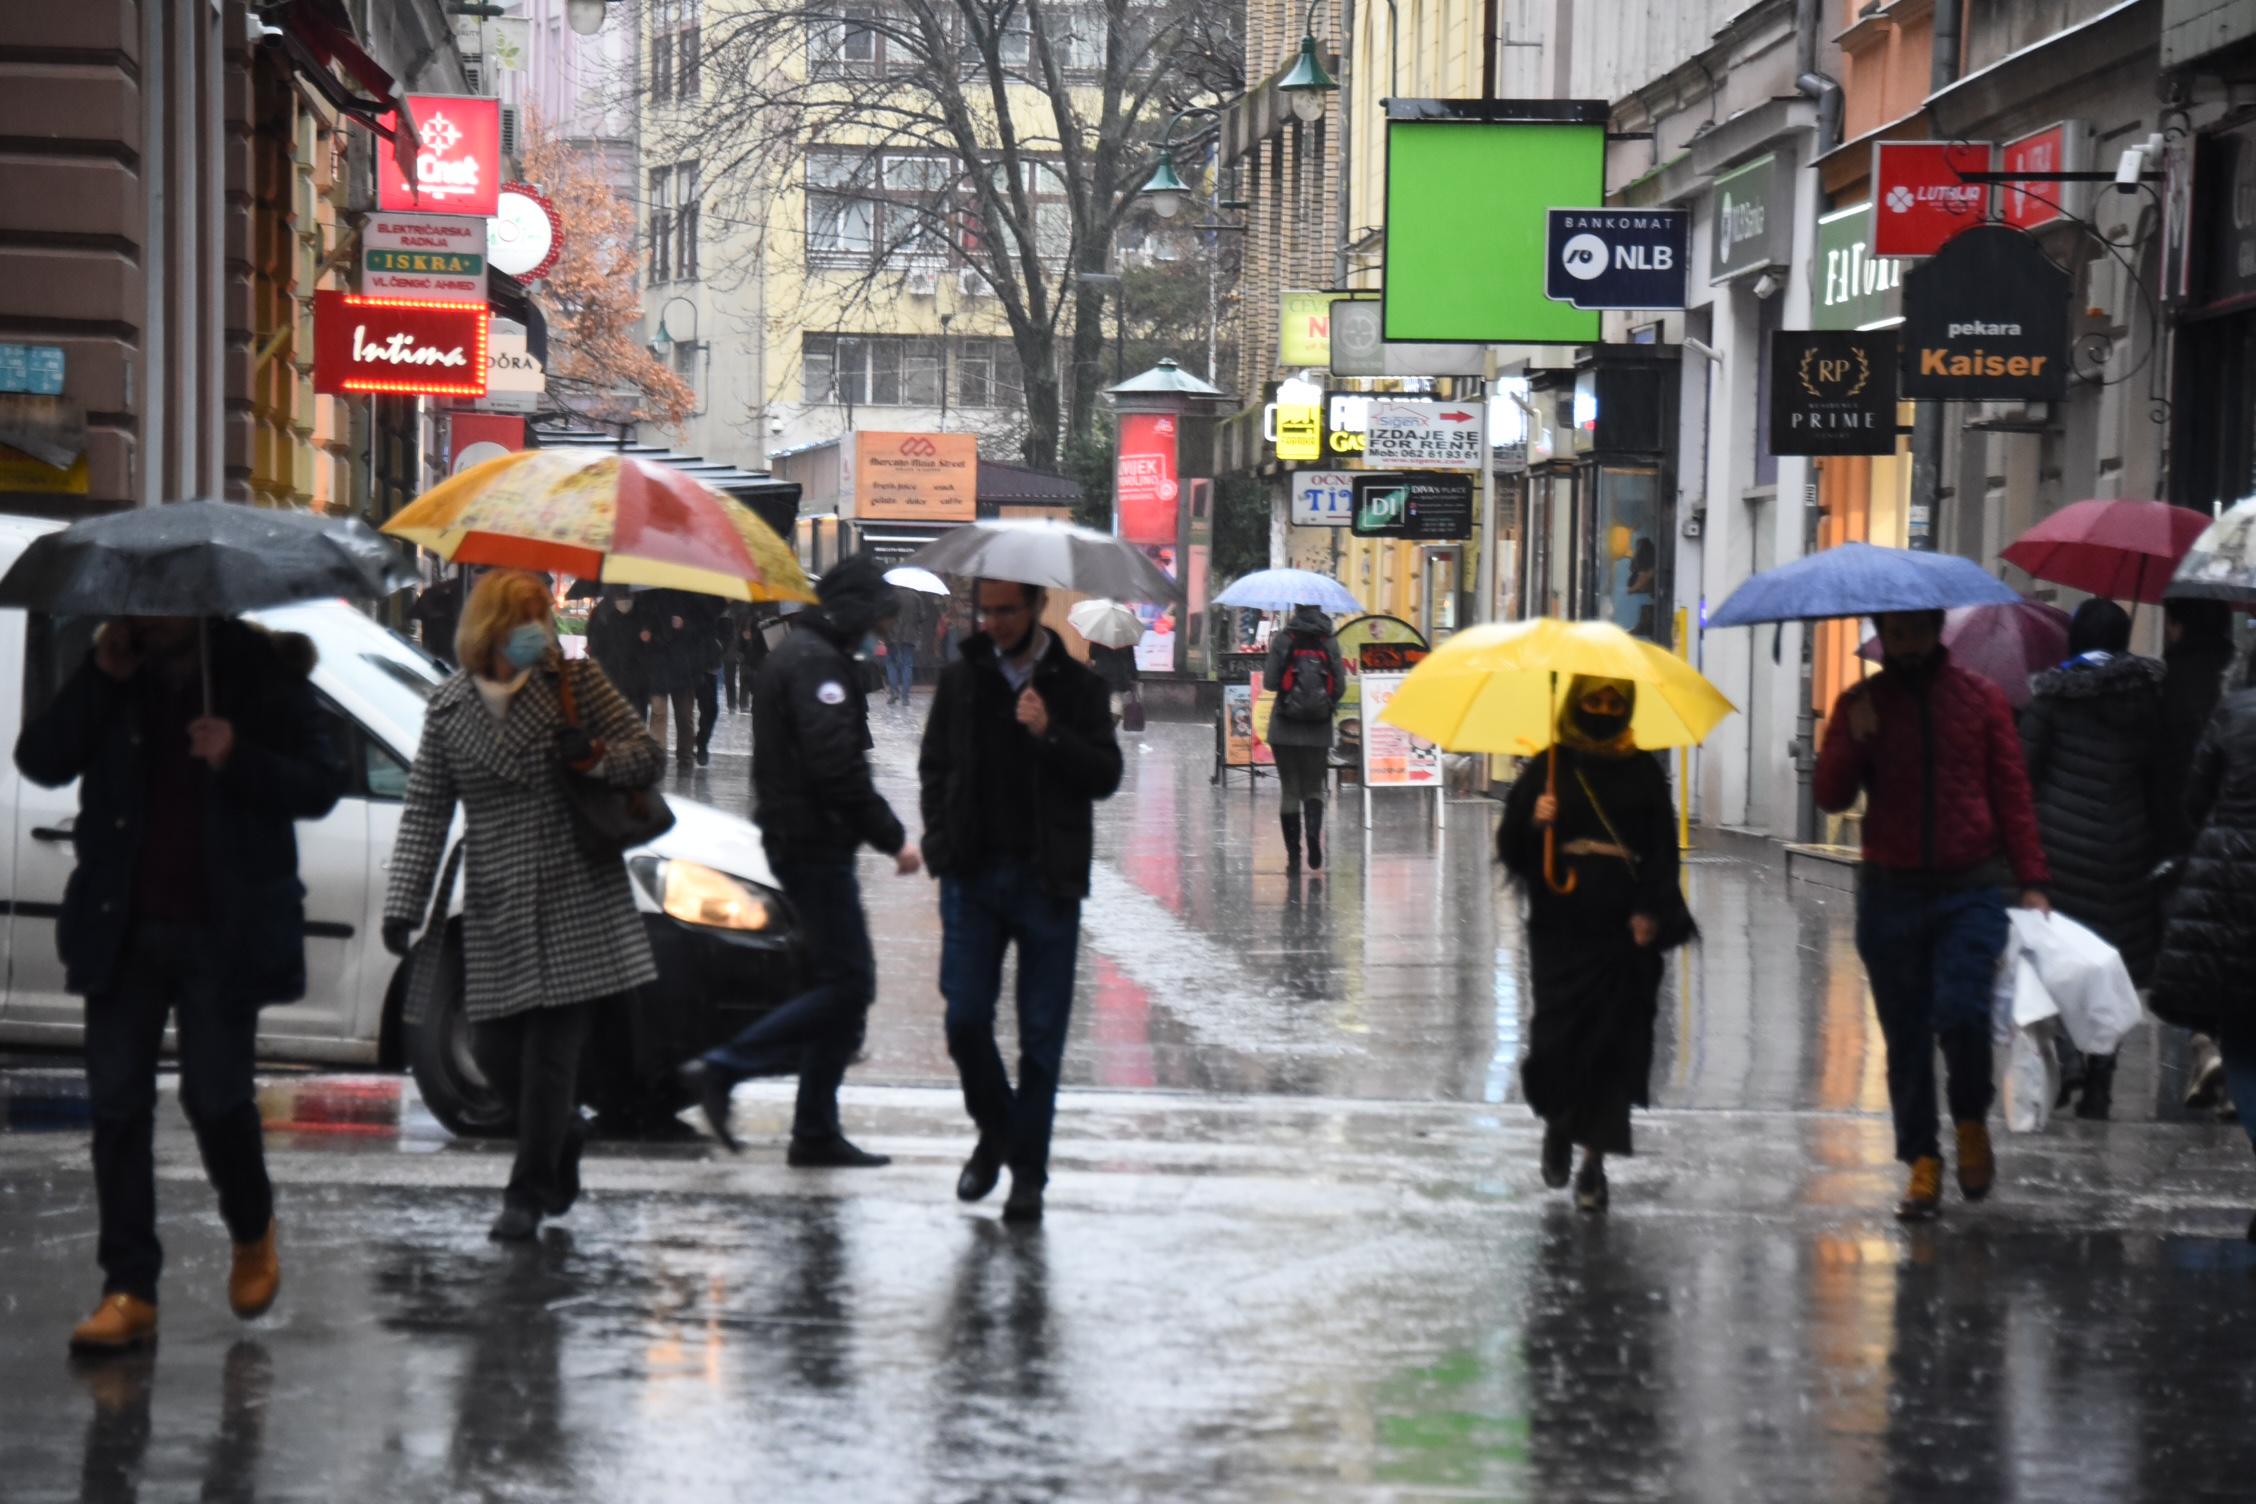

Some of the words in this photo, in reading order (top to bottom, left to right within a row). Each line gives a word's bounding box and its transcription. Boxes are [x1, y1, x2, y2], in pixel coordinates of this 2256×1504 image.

[1564, 217, 1673, 229] BANKOMAT
[400, 236, 448, 247] RADNJA
[385, 253, 464, 272] ISKRA
[1614, 245, 1673, 270] NLB
[435, 280, 476, 291] AHMED
[1308, 316, 1330, 338] N
[1948, 320, 2022, 338] pekara
[353, 325, 467, 368] Intima
[1819, 359, 1851, 382] RP
[1920, 348, 2047, 377] Kaiser
[1791, 412, 1877, 429] PRIME
[1369, 429, 1445, 441] IZDAJE
[1452, 431, 1479, 442] SE
[1369, 440, 1412, 449] FOR
[1420, 441, 1479, 450] RENT
[1369, 449, 1398, 457] Mob:
[1400, 449, 1424, 458] 062
[1371, 497, 1397, 516] DI
